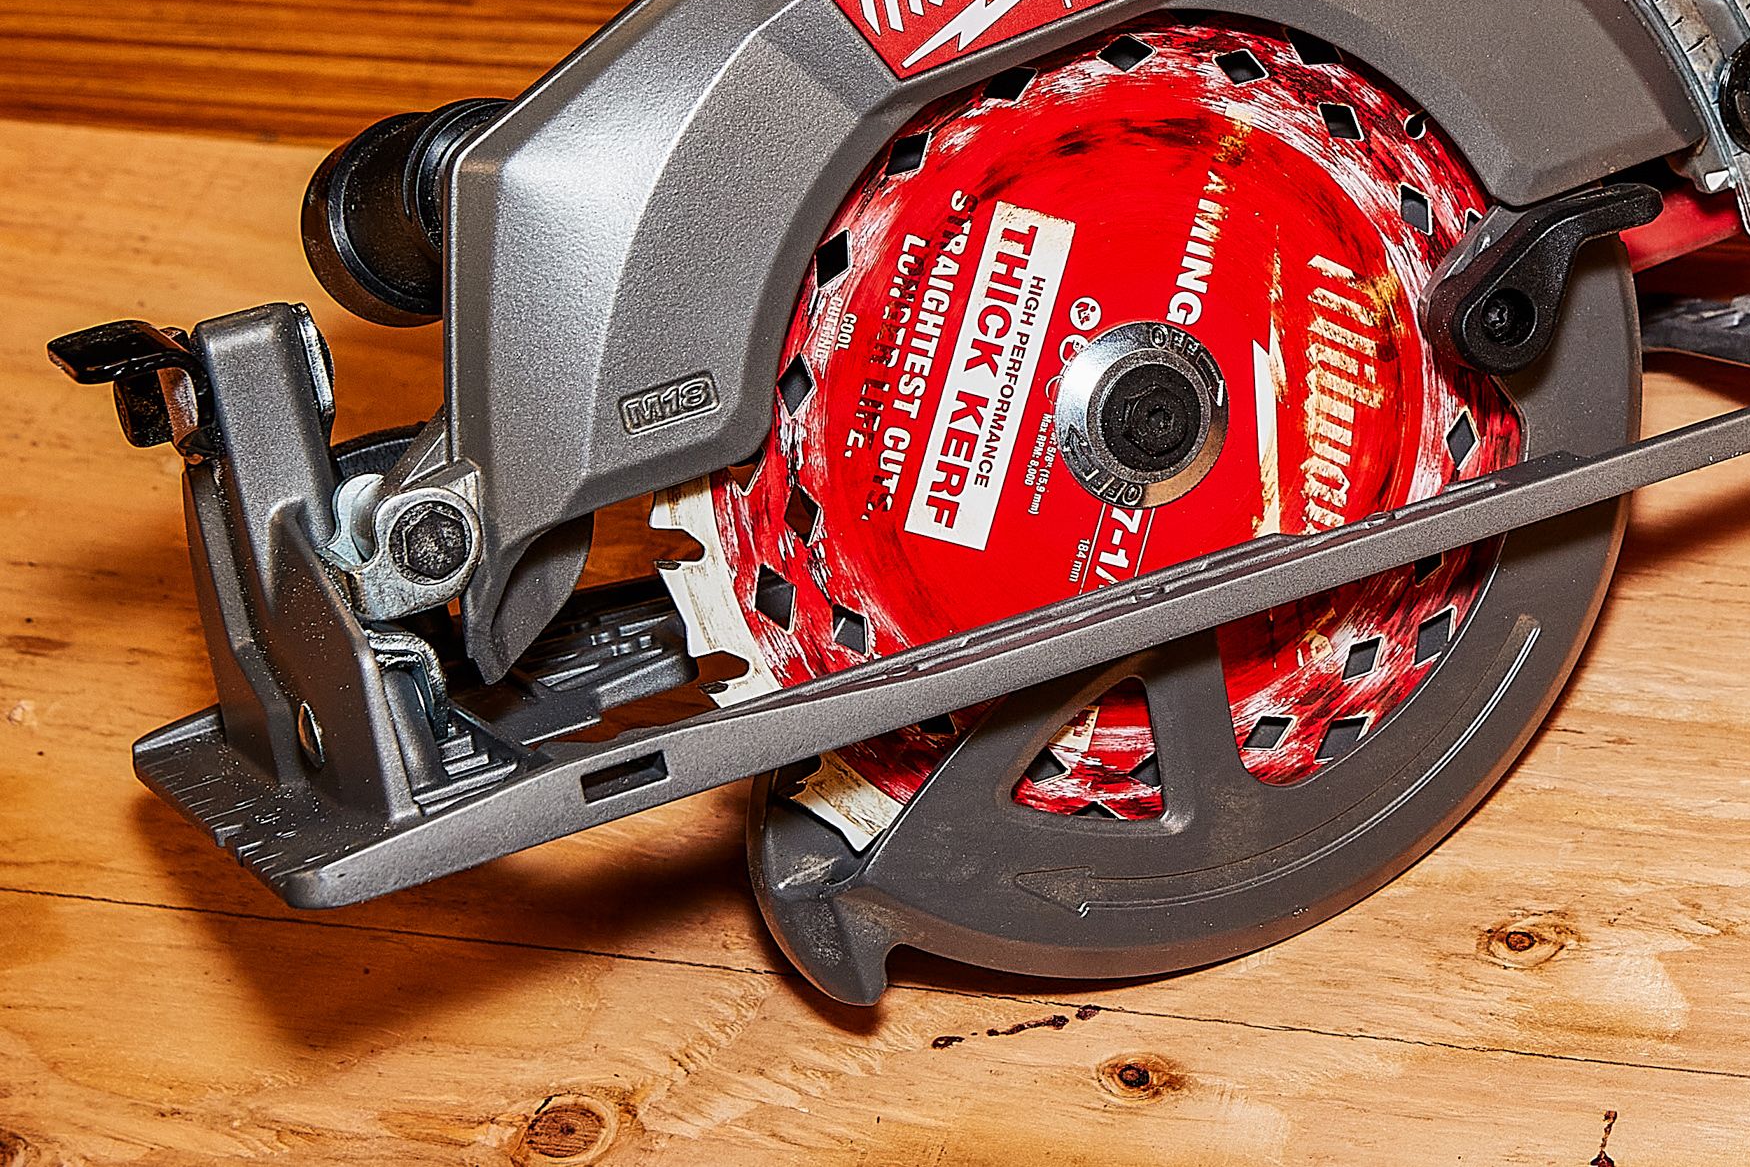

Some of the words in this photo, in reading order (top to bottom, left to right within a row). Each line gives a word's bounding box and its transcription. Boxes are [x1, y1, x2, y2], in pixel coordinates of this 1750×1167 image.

[891, 189, 979, 421] STRAIGHTEST
[962, 224, 1040, 378] THICK
[1020, 275, 1047, 327] HIGH
[834, 313, 858, 351] COOL
[623, 378, 709, 426] M18
[973, 332, 1031, 490] PERFORMANCE
[1039, 413, 1053, 433] Max
[925, 390, 990, 530] KERF
[1032, 434, 1047, 458] RPM:
[1024, 459, 1040, 486] 8,000
[1027, 493, 1042, 515] mm)
[1075, 538, 1091, 559] 184
[1095, 508, 1143, 588] 7-1/
[1068, 560, 1083, 583] mm
